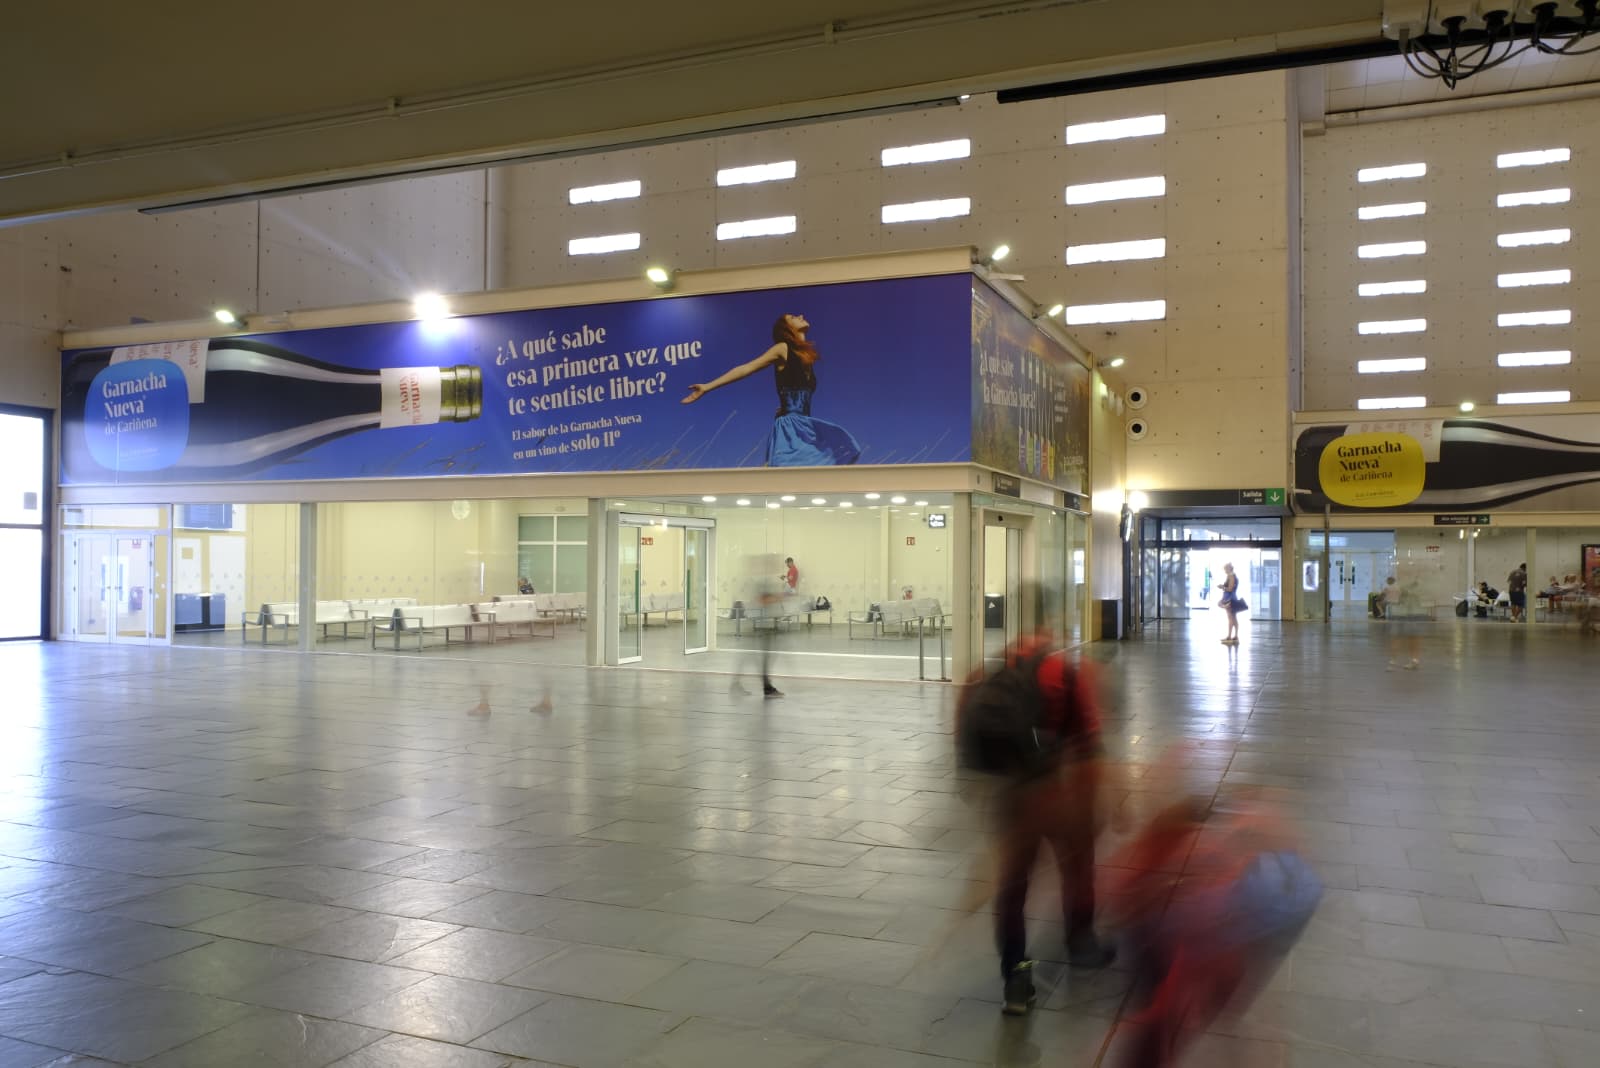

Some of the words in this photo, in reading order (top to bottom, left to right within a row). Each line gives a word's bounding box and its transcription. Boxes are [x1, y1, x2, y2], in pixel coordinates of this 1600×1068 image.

[495, 339, 518, 366] ¿A
[522, 330, 557, 361] qué
[561, 324, 607, 350] sabe
[506, 370, 538, 388] esa
[542, 354, 620, 387] primera
[625, 347, 659, 367] vez
[664, 340, 702, 366] que
[102, 371, 168, 399] Garnacha
[508, 396, 526, 416] te
[530, 382, 605, 413] sentiste
[609, 371, 667, 401] libre?
[104, 399, 145, 420] Nueva
[104, 421, 116, 435] de
[117, 417, 158, 433] Cariñena
[511, 429, 522, 441] El
[522, 425, 548, 440] sabor
[547, 424, 560, 437] de
[560, 422, 569, 434] la
[570, 416, 613, 432] Garnacha
[614, 413, 642, 426] Nueva
[513, 450, 524, 460] en
[525, 448, 537, 459] un
[538, 445, 557, 457] vino
[558, 442, 570, 454] de
[570, 432, 600, 453] solo
[1337, 440, 1403, 458] Garnacha
[1339, 458, 1380, 472] Nueva
[1340, 474, 1351, 483] de
